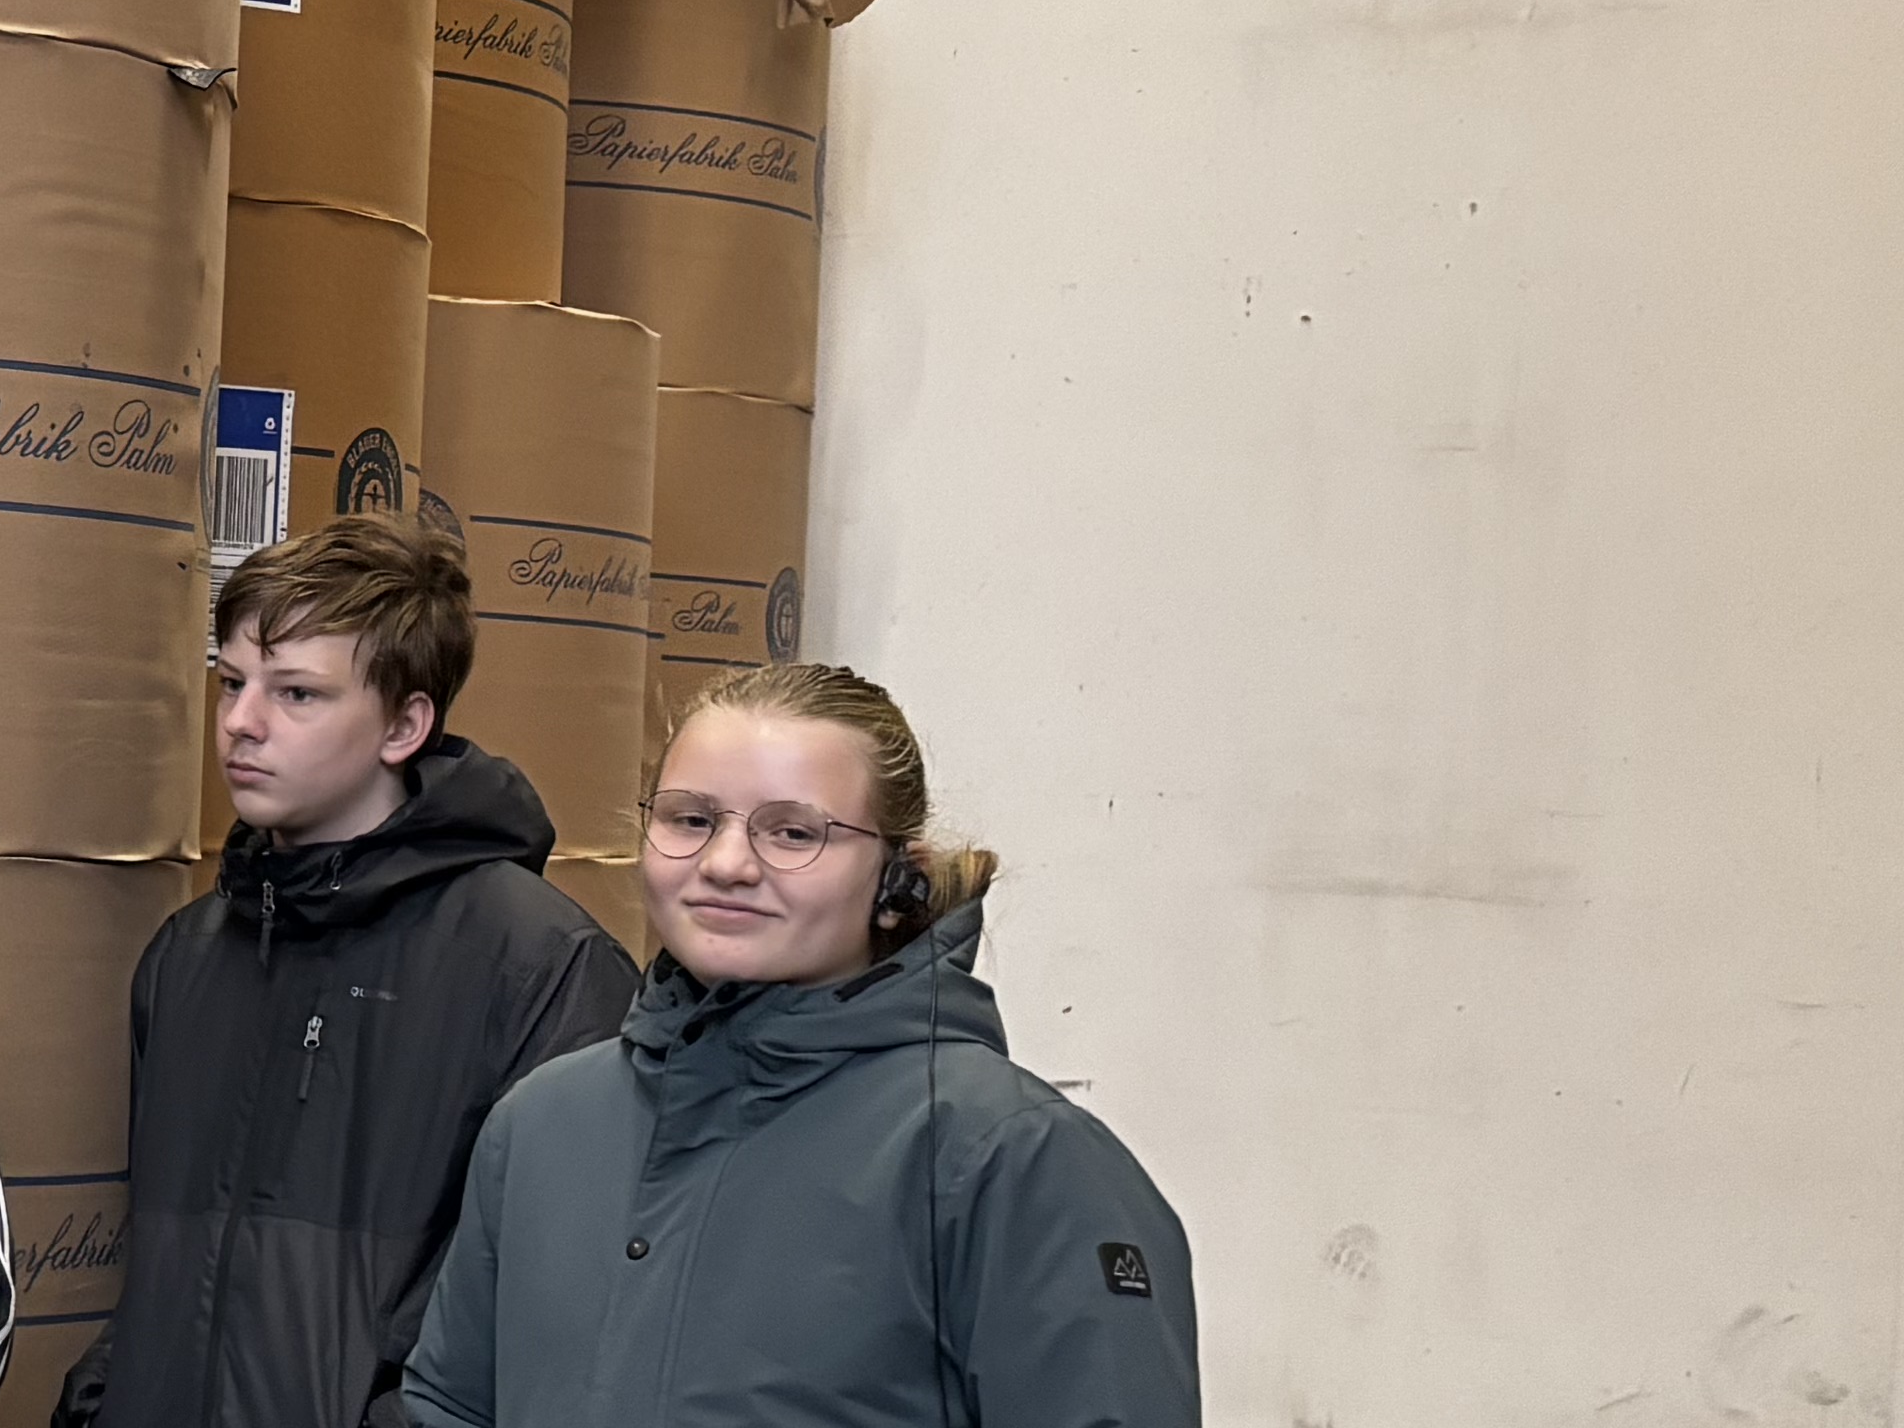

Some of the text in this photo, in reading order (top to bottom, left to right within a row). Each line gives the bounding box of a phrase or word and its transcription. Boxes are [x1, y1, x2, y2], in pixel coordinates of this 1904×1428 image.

[568, 114, 800, 185] Papierfabrik Palm
[89, 399, 175, 476] Palm
[672, 591, 739, 636] Palm
[13, 1212, 124, 1294] erfabrik
